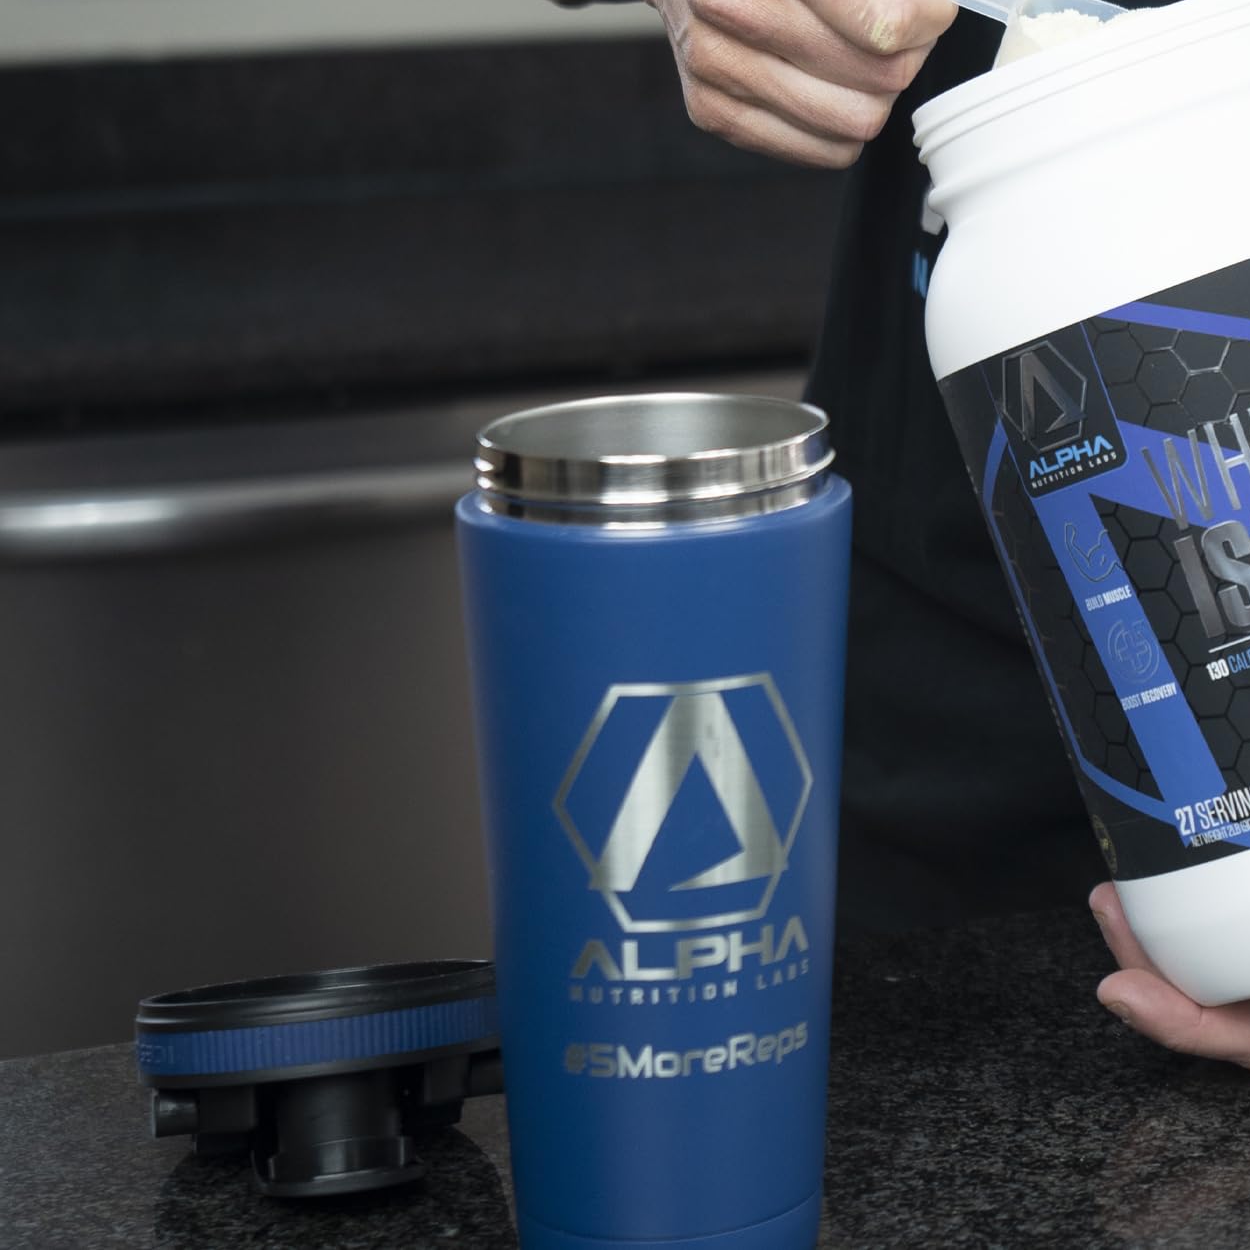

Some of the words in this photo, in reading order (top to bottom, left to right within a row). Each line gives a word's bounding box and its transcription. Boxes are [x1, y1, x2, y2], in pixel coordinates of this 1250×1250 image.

[1029, 435, 1113, 479] ALPHA
[1032, 465, 1083, 489] NUTRITION
[1088, 451, 1117, 469] LABS
[1102, 584, 1132, 605] MUSCLE
[1206, 658, 1230, 681] 130
[1140, 682, 1177, 705] RECOVERY
[1175, 805, 1197, 836] 27
[570, 915, 809, 981] ALPHA
[570, 979, 738, 1006] NUTRITION
[755, 958, 809, 991] LABS
